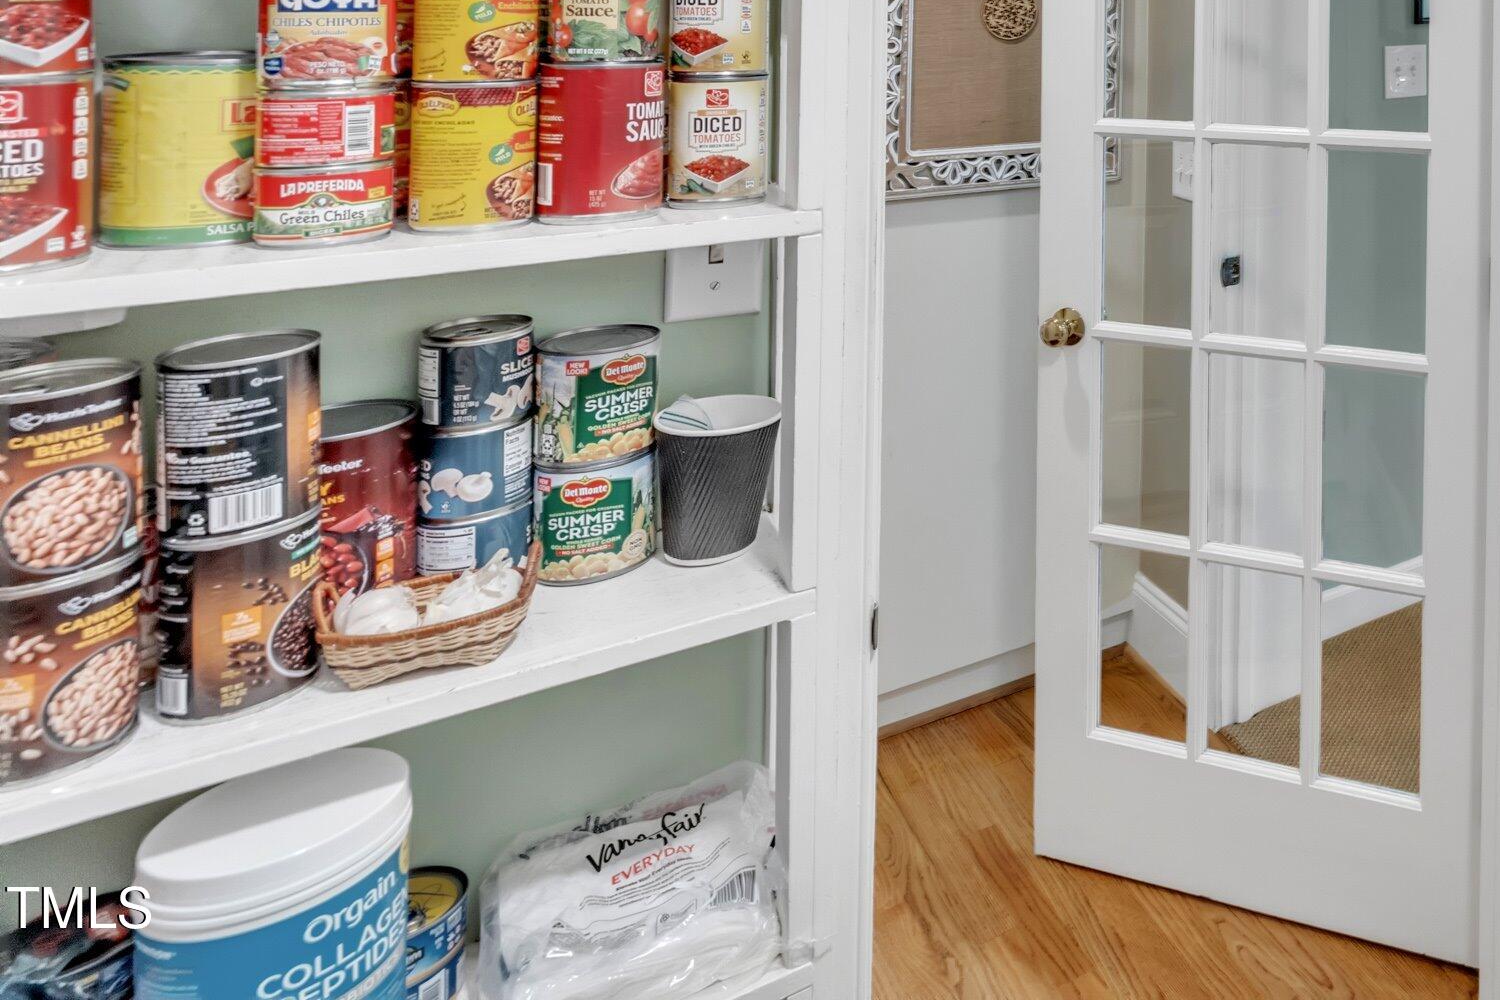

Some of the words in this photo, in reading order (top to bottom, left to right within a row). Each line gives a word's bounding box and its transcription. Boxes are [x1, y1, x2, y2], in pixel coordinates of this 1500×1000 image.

[474, 9, 493, 20] MILD
[566, 4, 614, 17] Sauce
[676, 7, 717, 16] TOMATOES
[272, 16, 312, 27] CHILES
[316, 16, 381, 28] CHIPOTLES
[626, 100, 665, 119] TOMAT
[626, 120, 665, 142] SAUC
[693, 116, 742, 133] DICED
[693, 133, 741, 144] TOMATOES
[280, 182, 296, 198] LA
[297, 178, 365, 194] PREFERIDA
[280, 211, 320, 225] Green
[324, 208, 365, 222] Chiles
[501, 355, 534, 375] SLICE
[606, 366, 620, 377] Del
[621, 361, 645, 375] Monte
[585, 386, 653, 413] SUMMER
[595, 399, 648, 421] CRISP
[33, 433, 104, 459] BEANS
[564, 488, 578, 497] Del
[579, 485, 608, 496] Monte
[548, 509, 625, 531] SUMMER
[556, 522, 616, 541] CRISP
[601, 535, 621, 545] CORN
[290, 550, 320, 578] BLA
[661, 803, 706, 840] fair
[611, 843, 696, 886] EVERYDAY
[303, 870, 396, 944] Orgain
